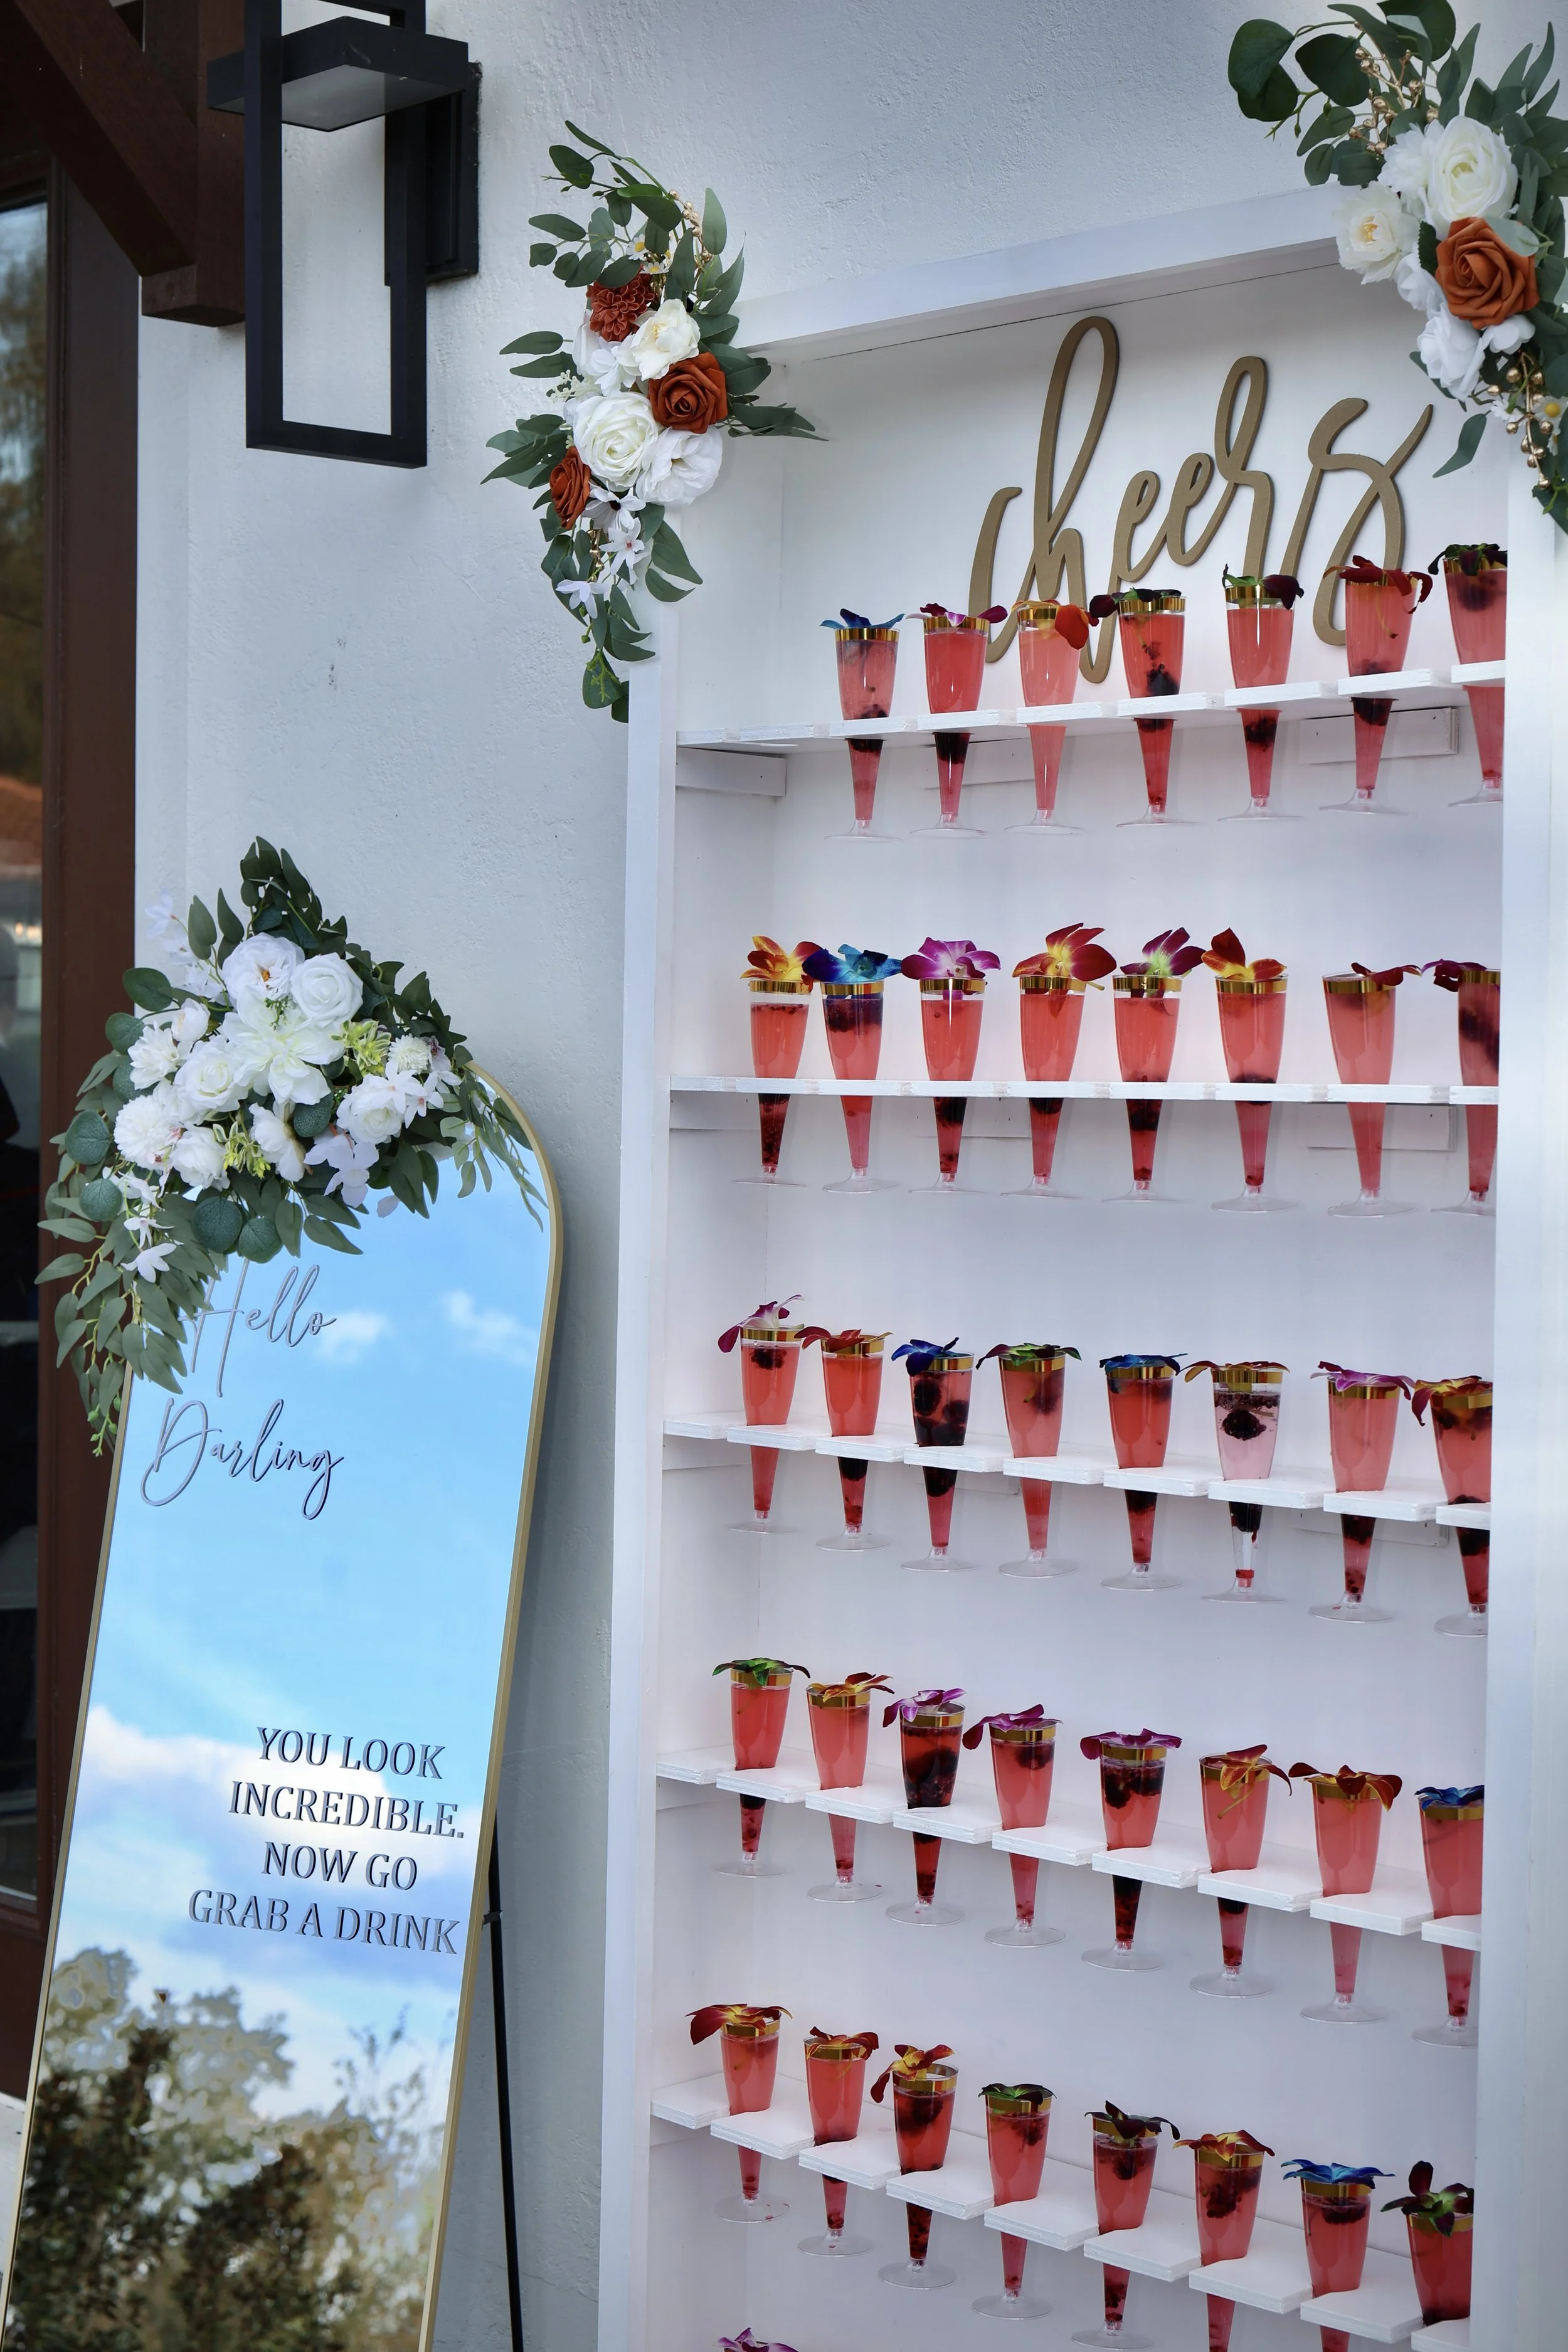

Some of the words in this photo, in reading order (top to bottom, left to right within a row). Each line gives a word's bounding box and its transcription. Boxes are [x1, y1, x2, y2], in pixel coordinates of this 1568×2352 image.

[968, 315, 1434, 684] cheers
[177, 1257, 337, 1397] Hello
[140, 1398, 344, 1520] Darling
[257, 1727, 332, 1766] YOU
[339, 1735, 446, 1779] LOOK
[228, 1781, 464, 1838] INCREDIBLE.
[261, 1841, 358, 1883] NOW
[366, 1853, 418, 1890] GO
[188, 1890, 289, 1932] GRAB
[295, 1903, 323, 1938] A
[333, 1906, 460, 1955] DRINK
